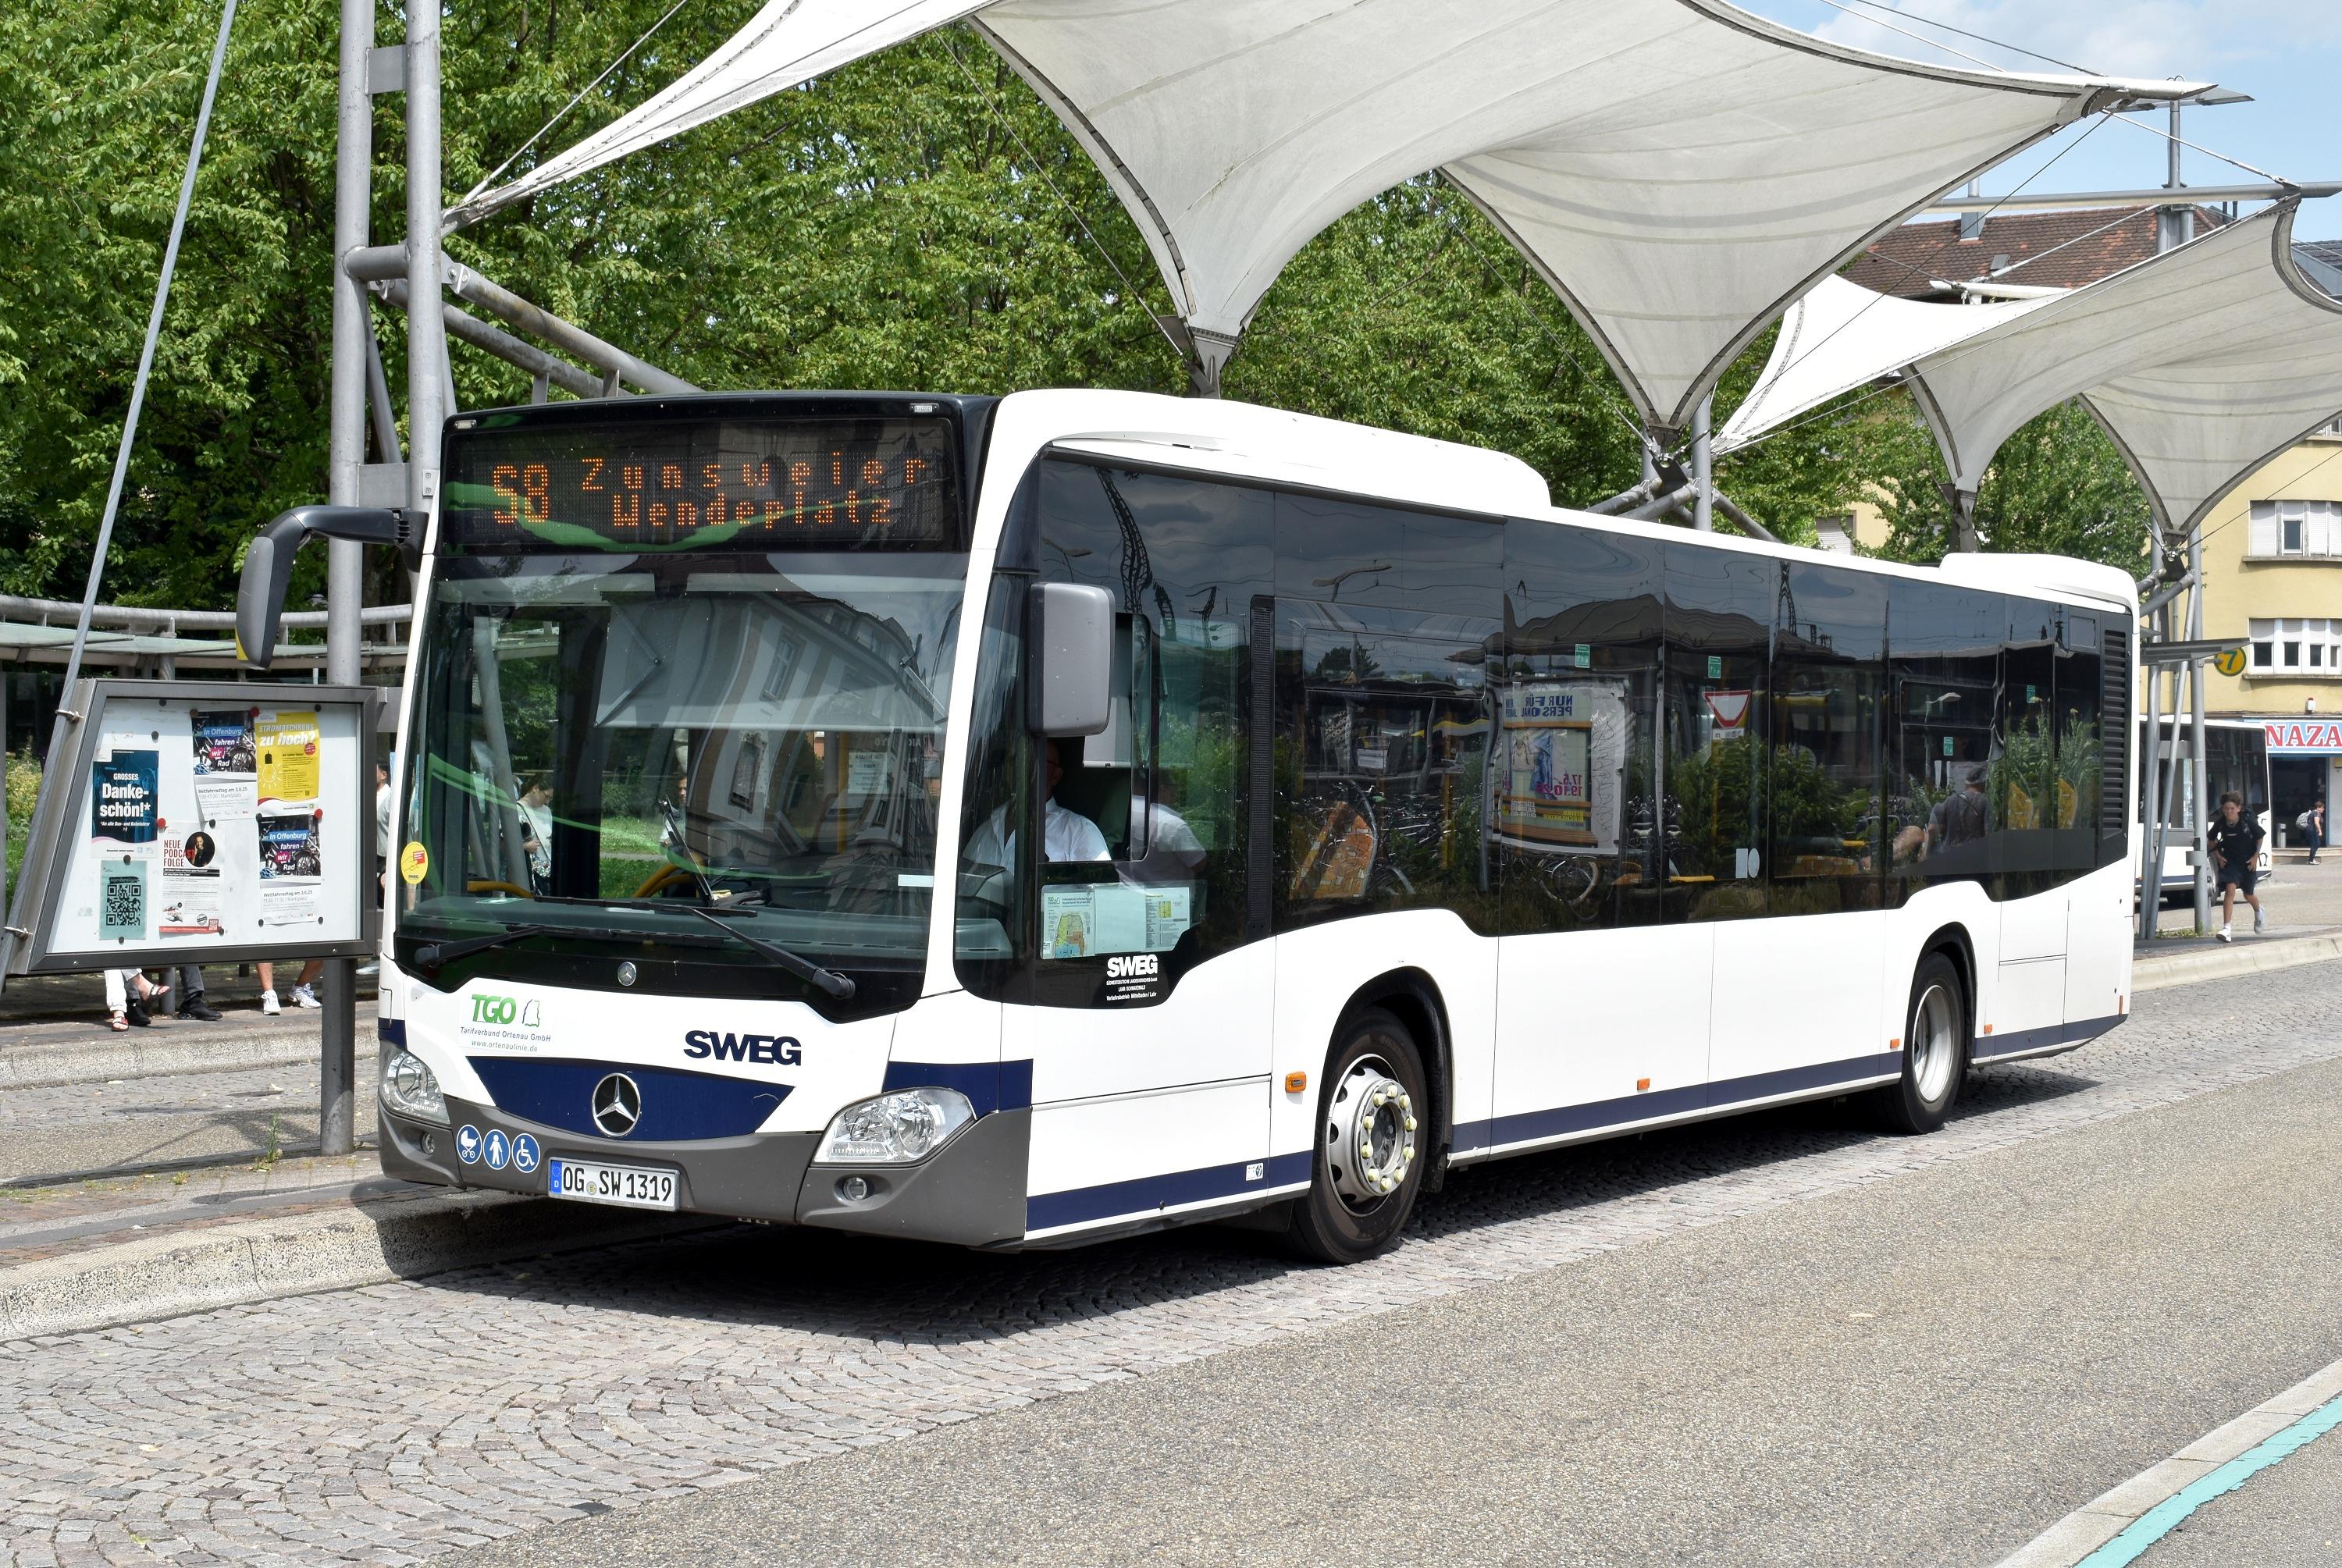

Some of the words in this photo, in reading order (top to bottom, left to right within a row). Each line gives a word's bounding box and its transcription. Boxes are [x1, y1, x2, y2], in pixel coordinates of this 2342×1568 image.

[582, 452, 926, 489] Zunsweier
[614, 489, 891, 528] Wendeplatz
[2223, 649, 2238, 670] 7
[211, 727, 243, 736] Offenburg
[259, 734, 275, 747] zu
[277, 731, 315, 746] hoch?
[102, 783, 149, 799] Danke-
[163, 840, 181, 849] NEUE
[163, 848, 196, 859] PODCAST
[163, 858, 184, 867] FOLGE
[1106, 955, 1159, 978] SWEG
[472, 994, 517, 1025] TGO
[461, 1027, 500, 1037] Tarifverbund
[502, 1031, 529, 1040] Ortenau
[530, 1033, 551, 1042] GmbH
[472, 1040, 538, 1052] www.ortenaulinie.de
[683, 1030, 802, 1066] SWEG
[563, 1166, 585, 1193] OG
[599, 1170, 621, 1196] SW
[626, 1173, 672, 1202] 1319
